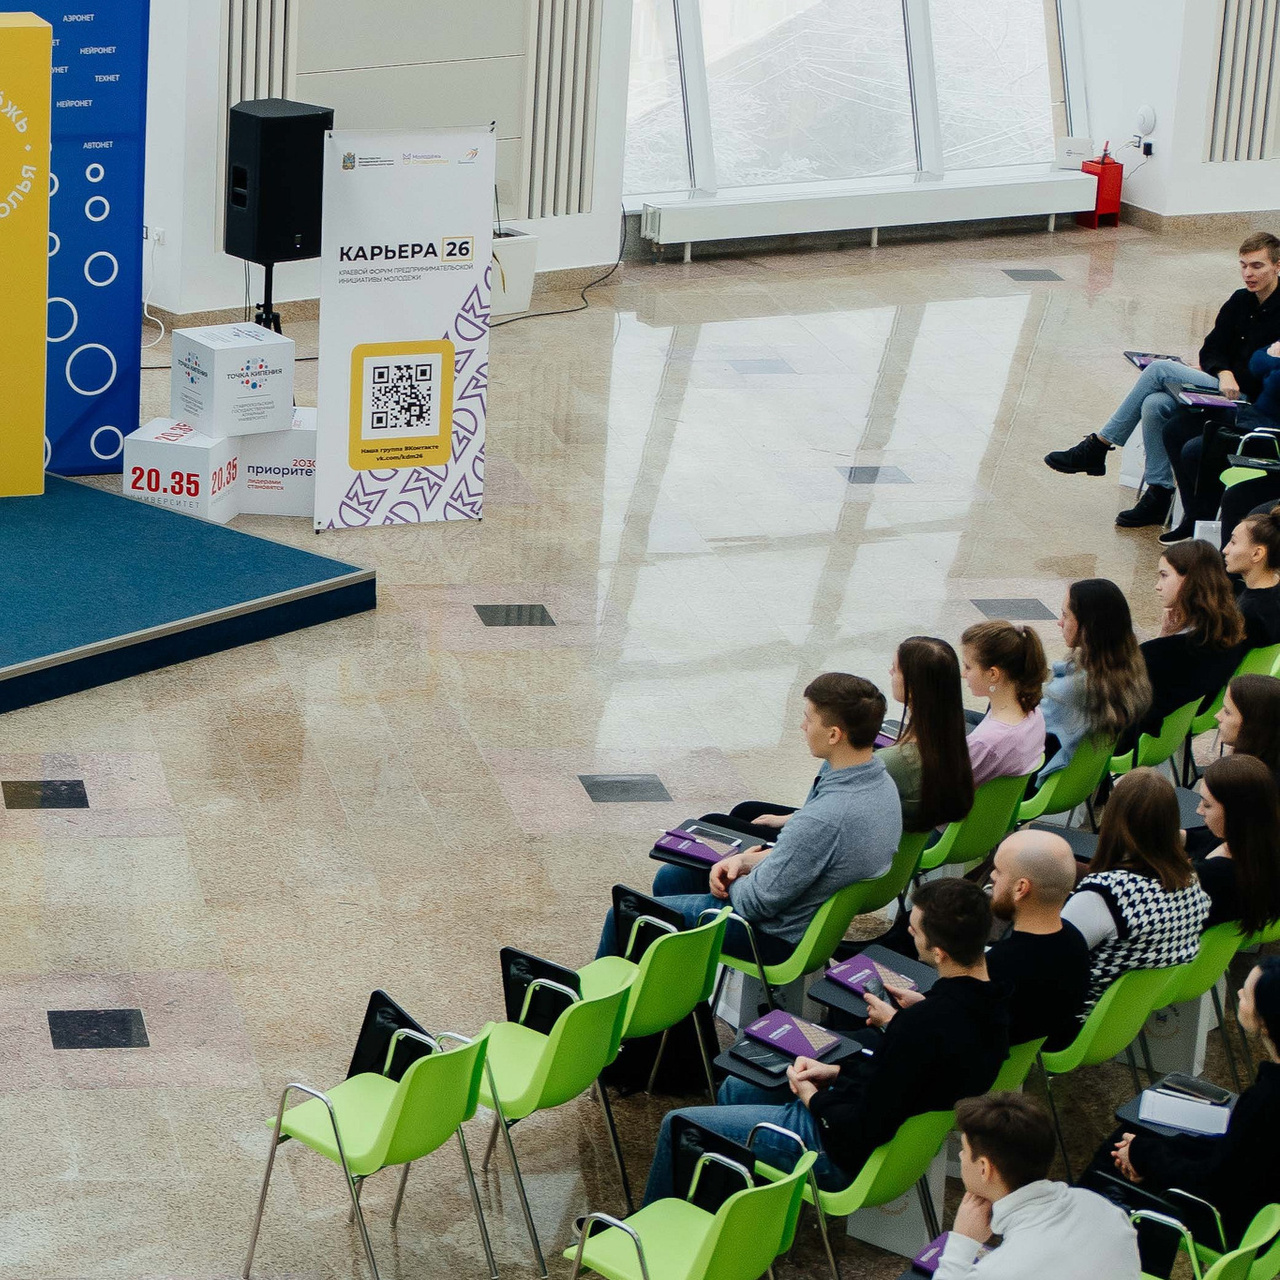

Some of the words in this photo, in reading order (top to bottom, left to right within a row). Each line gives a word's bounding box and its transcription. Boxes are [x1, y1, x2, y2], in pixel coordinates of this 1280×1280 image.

[62, 14, 95, 23] АЭРОНЕТ
[79, 46, 117, 55] НЕЙРОНЕТ
[95, 74, 120, 83] ТЕХНЕТ
[56, 99, 93, 108] НЕЙРОНЕТ
[82, 141, 113, 150] АВТОНЕТ
[339, 242, 438, 262] КАРЬЕРА
[445, 241, 470, 257] 26
[338, 267, 367, 276] КРАЕВОЙ
[369, 267, 393, 275] ФОРУМ
[394, 263, 473, 273] ПРЕДПРИНИМАТЕЛЬСКОЙ
[338, 275, 382, 284] ИНИЦИАТИВЫ
[227, 372, 249, 380] ТОЧКА
[250, 368, 283, 378] КИПЕНИЯ
[376, 453, 423, 461] vk.com/kdm26
[211, 456, 238, 496] 20.35
[247, 465, 316, 478] приорите
[131, 466, 200, 497] 20.35
